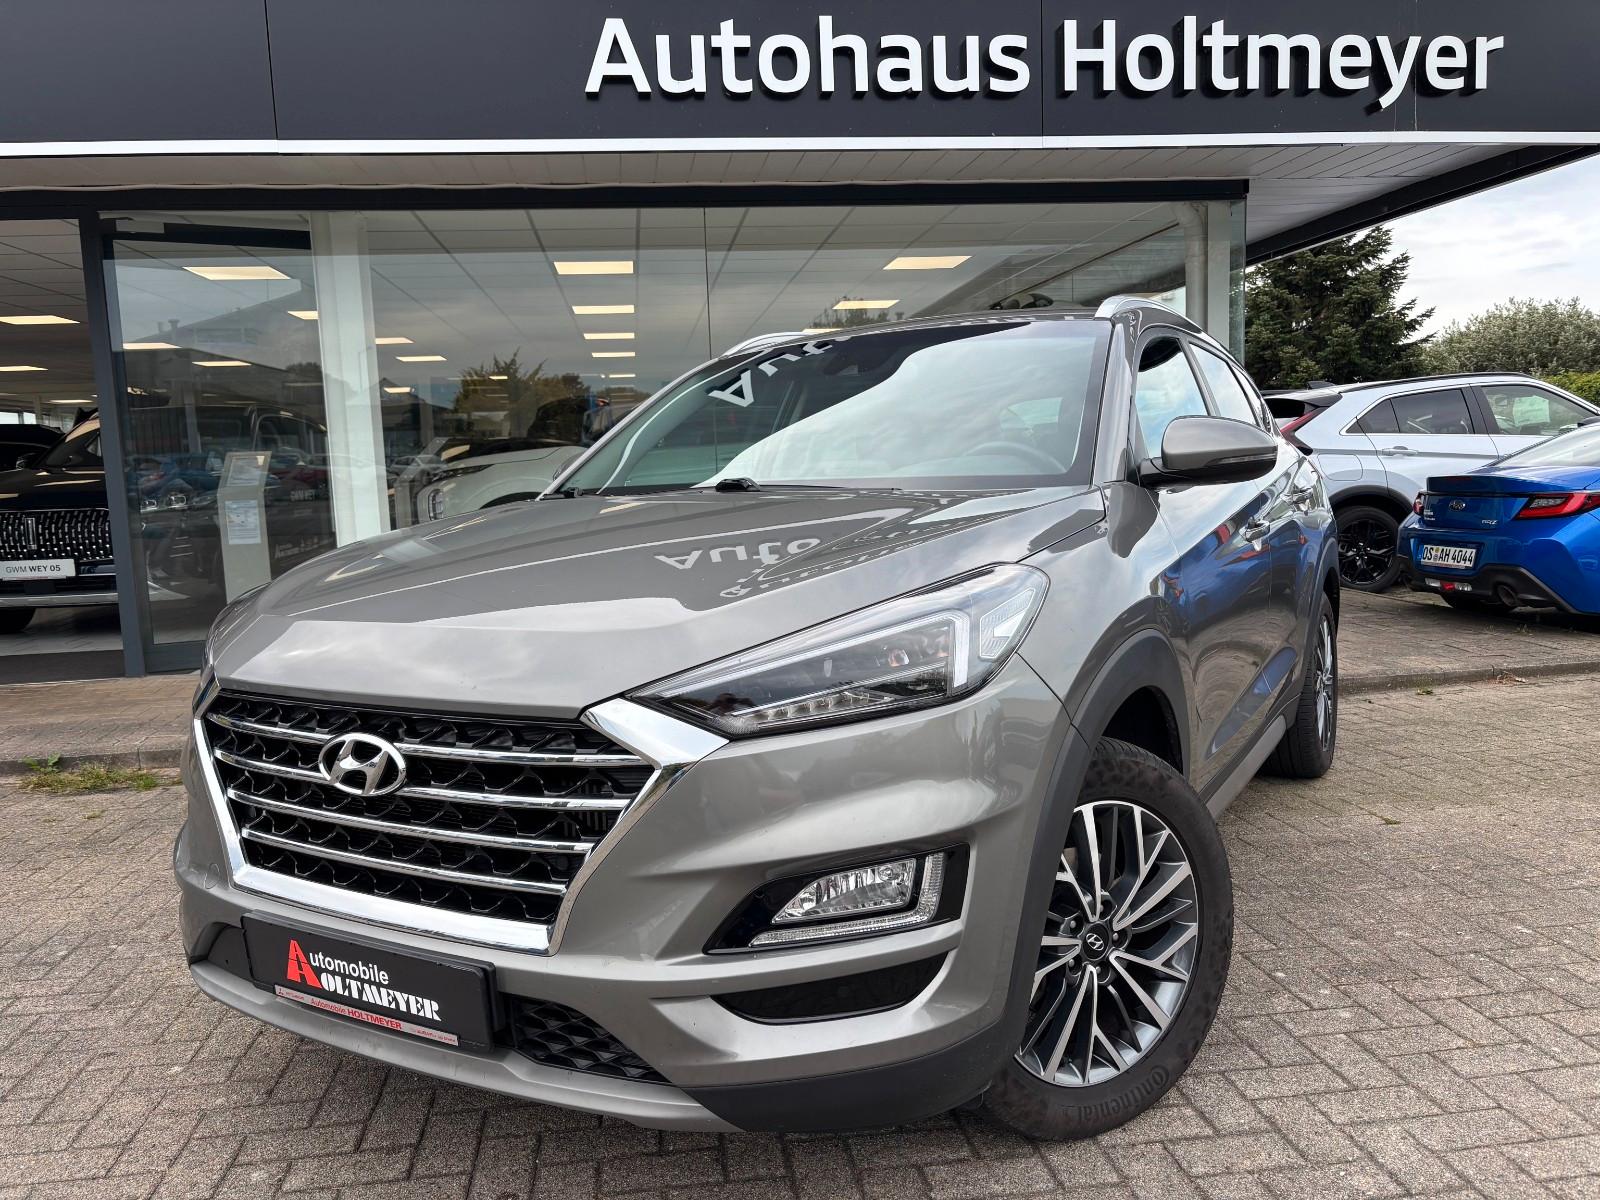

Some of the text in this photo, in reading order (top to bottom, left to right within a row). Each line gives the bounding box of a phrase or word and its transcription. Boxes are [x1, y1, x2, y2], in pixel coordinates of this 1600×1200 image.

[585, 15, 1505, 109] Autohaus Holtmeyer
[1422, 546, 1434, 561] OS
[1438, 547, 1451, 563] AH
[1451, 549, 1474, 565] 4044
[5, 564, 61, 574] GWM WEY 05
[347, 1008, 403, 1031] HOLTMEYER
[1077, 1064, 1170, 1122] Continental
